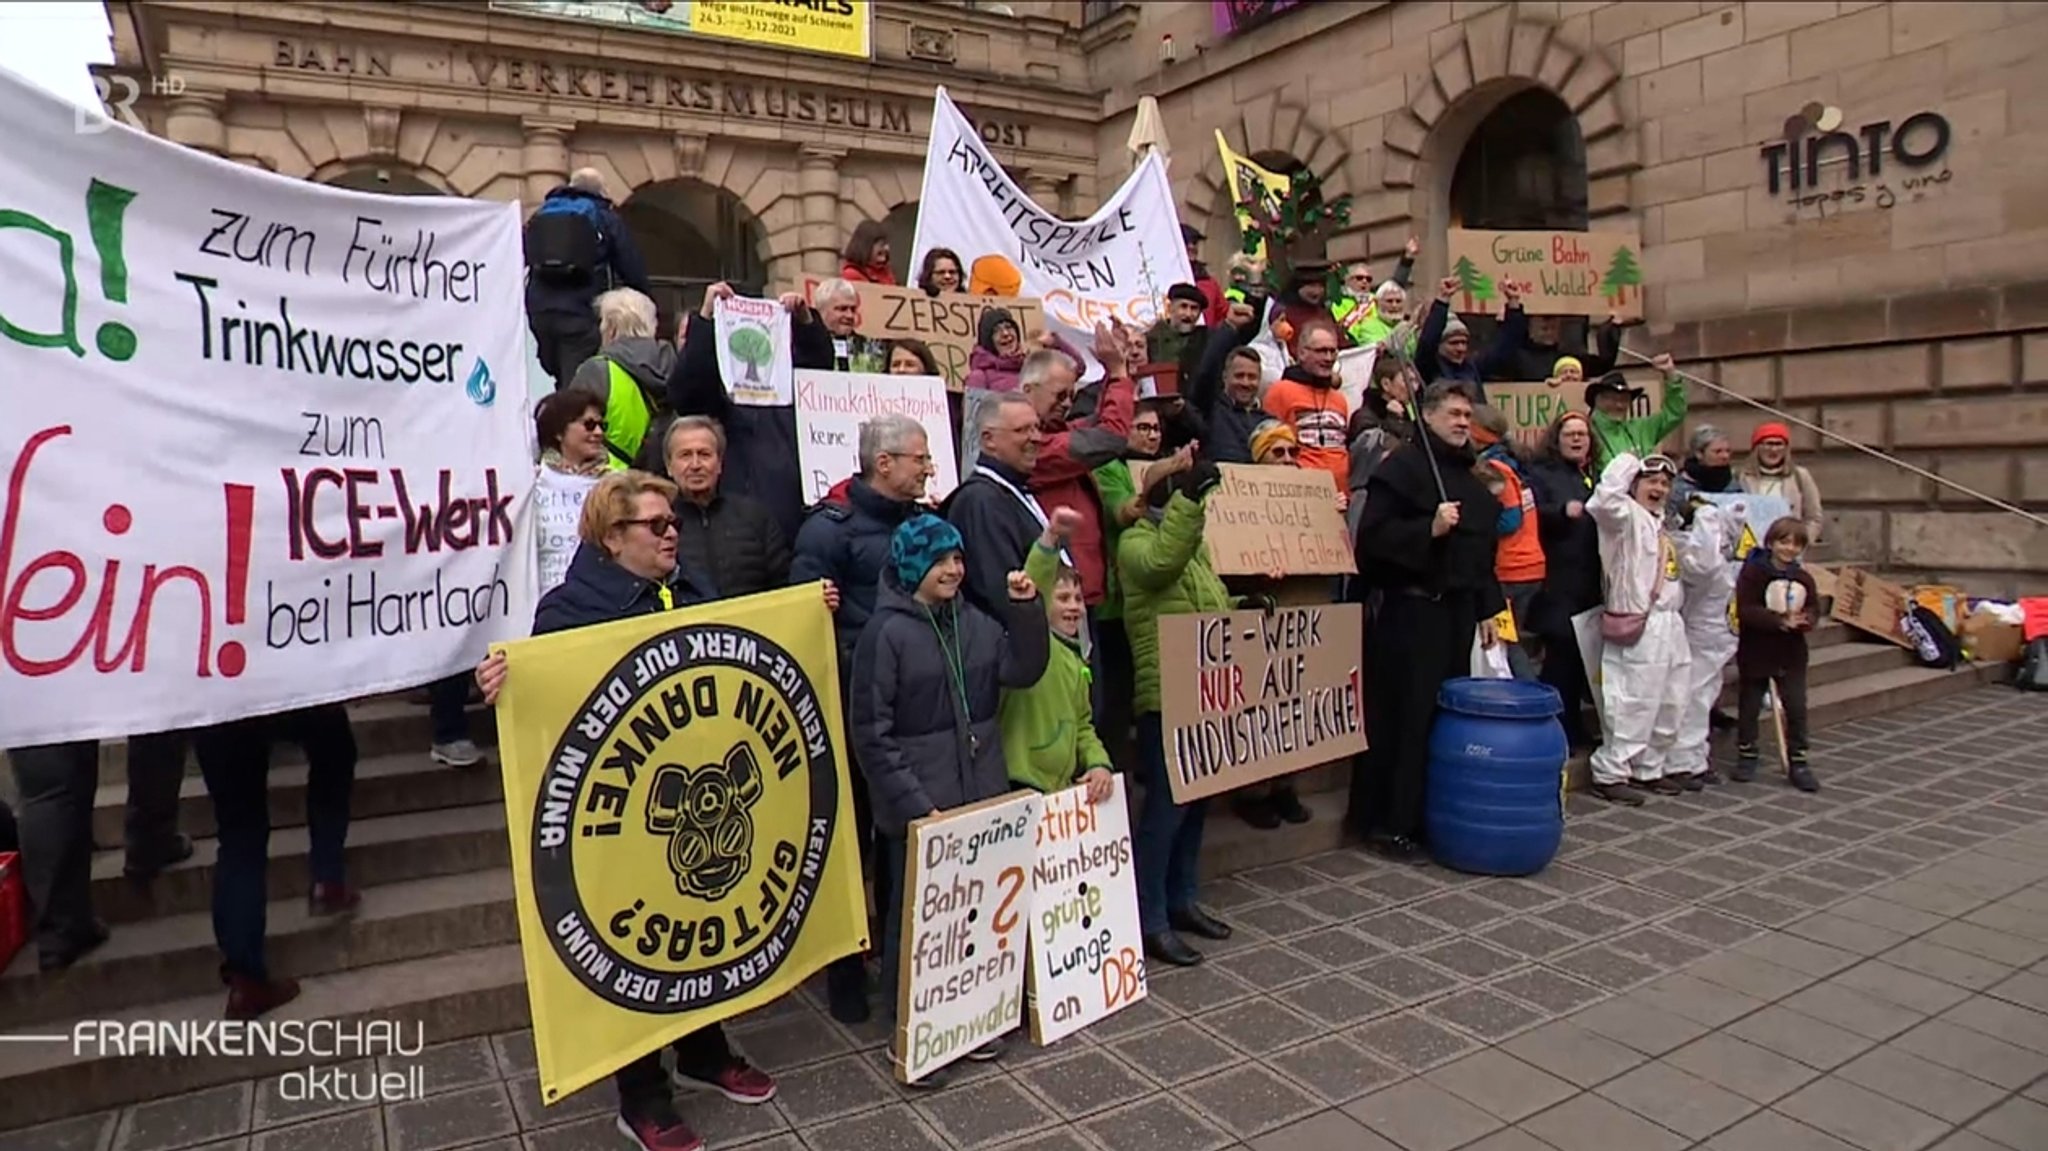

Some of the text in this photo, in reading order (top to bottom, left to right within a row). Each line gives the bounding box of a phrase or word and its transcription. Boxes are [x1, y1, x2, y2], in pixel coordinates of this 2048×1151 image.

[274, 41, 391, 76] BAHN
[467, 51, 912, 133] VERKEHRSMUSEUM
[978, 121, 1031, 147] OST
[343, 217, 485, 302] Fürther
[1492, 235, 1591, 264] Grüne Bahn
[1540, 269, 1599, 297] Wald?
[174, 271, 463, 382] Trinkwasser
[300, 412, 384, 458] zum
[281, 468, 514, 560] ICE-Werk
[1240, 532, 1289, 570] nicht
[267, 565, 509, 649] bei Harrlach
[634, 638, 679, 687] AUF
[1199, 654, 1305, 714] NUR AUF
[576, 685, 629, 742] DER
[793, 694, 828, 758] KEIN
[1174, 665, 1362, 786] INDUSTRIEFLÄCHE!
[583, 675, 802, 839] NEIN DANKE!
[539, 747, 589, 848] MUNA
[799, 816, 828, 881] KEIN
[1032, 835, 1130, 892] Nürnbergs
[609, 840, 799, 963] GIFTGAS?
[922, 873, 983, 922] Bahn
[1041, 882, 1102, 944] grüne
[556, 910, 610, 979] MUNA
[913, 917, 972, 976] fällt
[1047, 928, 1112, 978] Lunge
[613, 967, 660, 1003] DER
[665, 975, 714, 1005] AUF
[914, 950, 1015, 1012] unseren
[1053, 995, 1081, 1022] an
[912, 984, 1019, 1070] Bannwald
